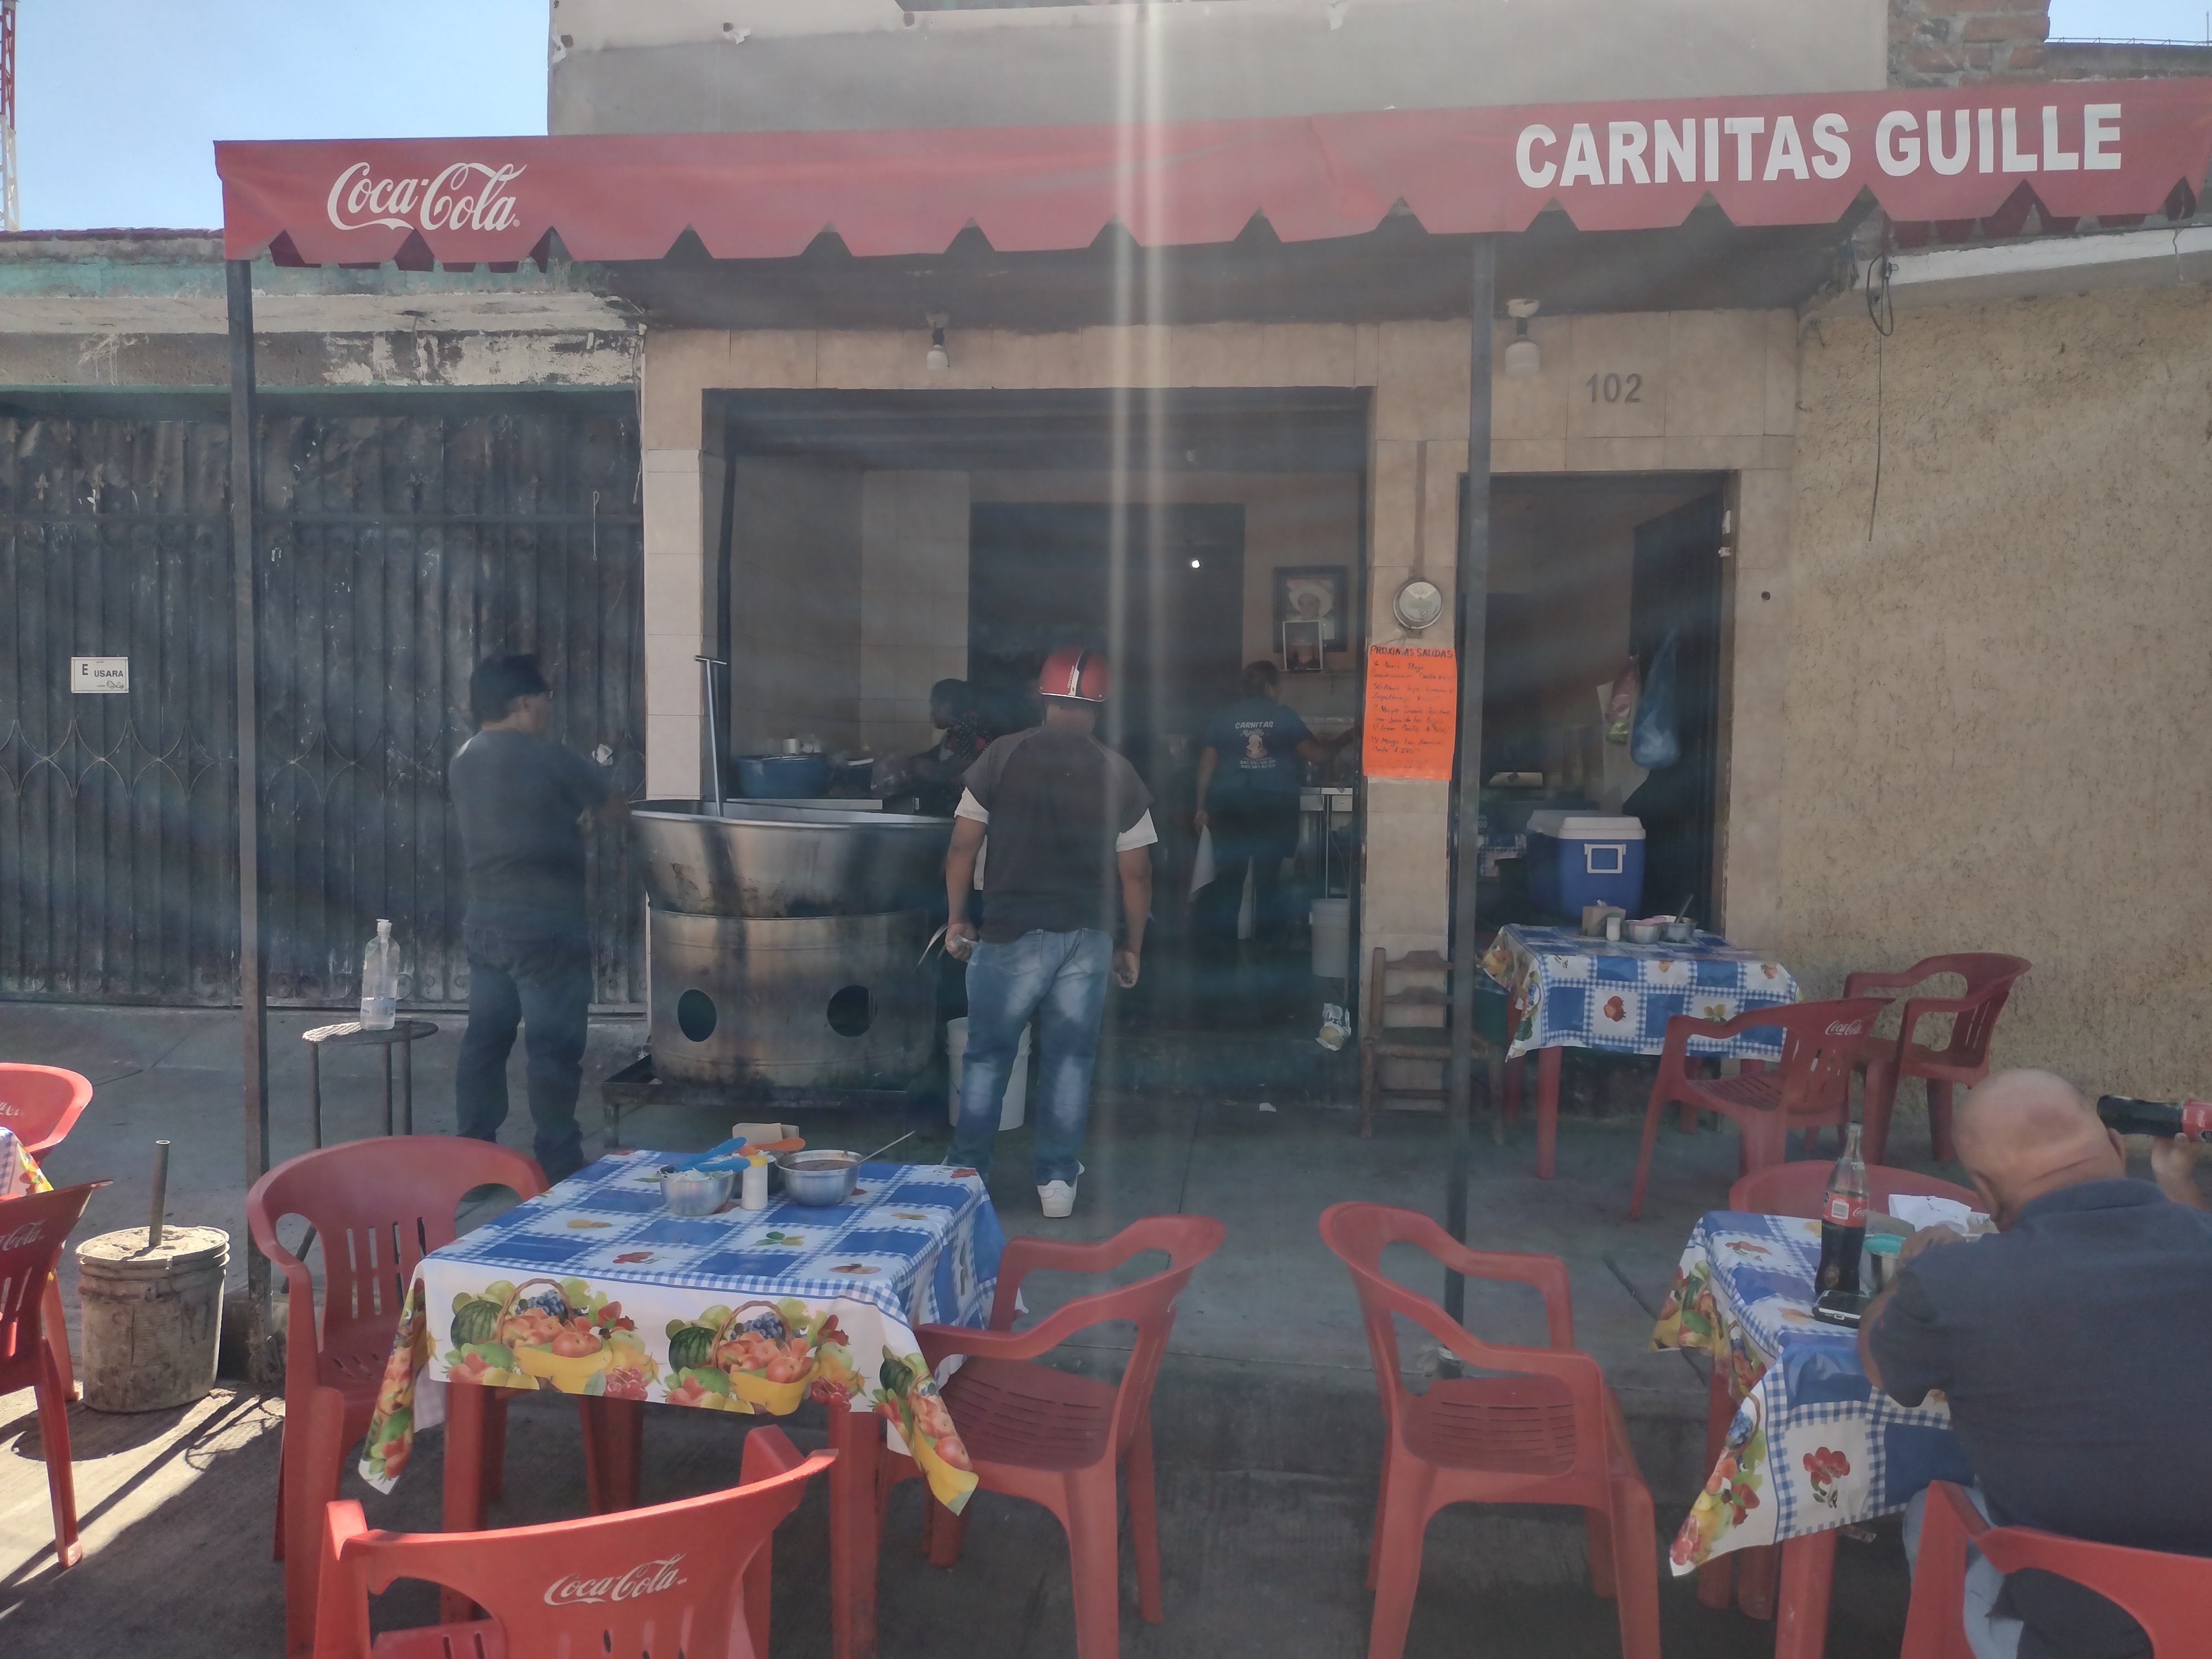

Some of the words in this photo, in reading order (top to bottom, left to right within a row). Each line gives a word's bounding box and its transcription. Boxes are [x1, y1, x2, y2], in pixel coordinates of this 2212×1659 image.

[1515, 112, 1851, 189] CARNITAS
[1875, 103, 2122, 177] GUILLE
[327, 161, 528, 231] Coca-Cola
[1586, 372, 1643, 404] 102
[1369, 645, 1415, 656] PROXIMAS
[1417, 648, 1453, 658] SALIDAS
[82, 664, 88, 676] E
[1235, 721, 1274, 729] CARNITAS
[544, 1552, 688, 1606] Coca-Cola
